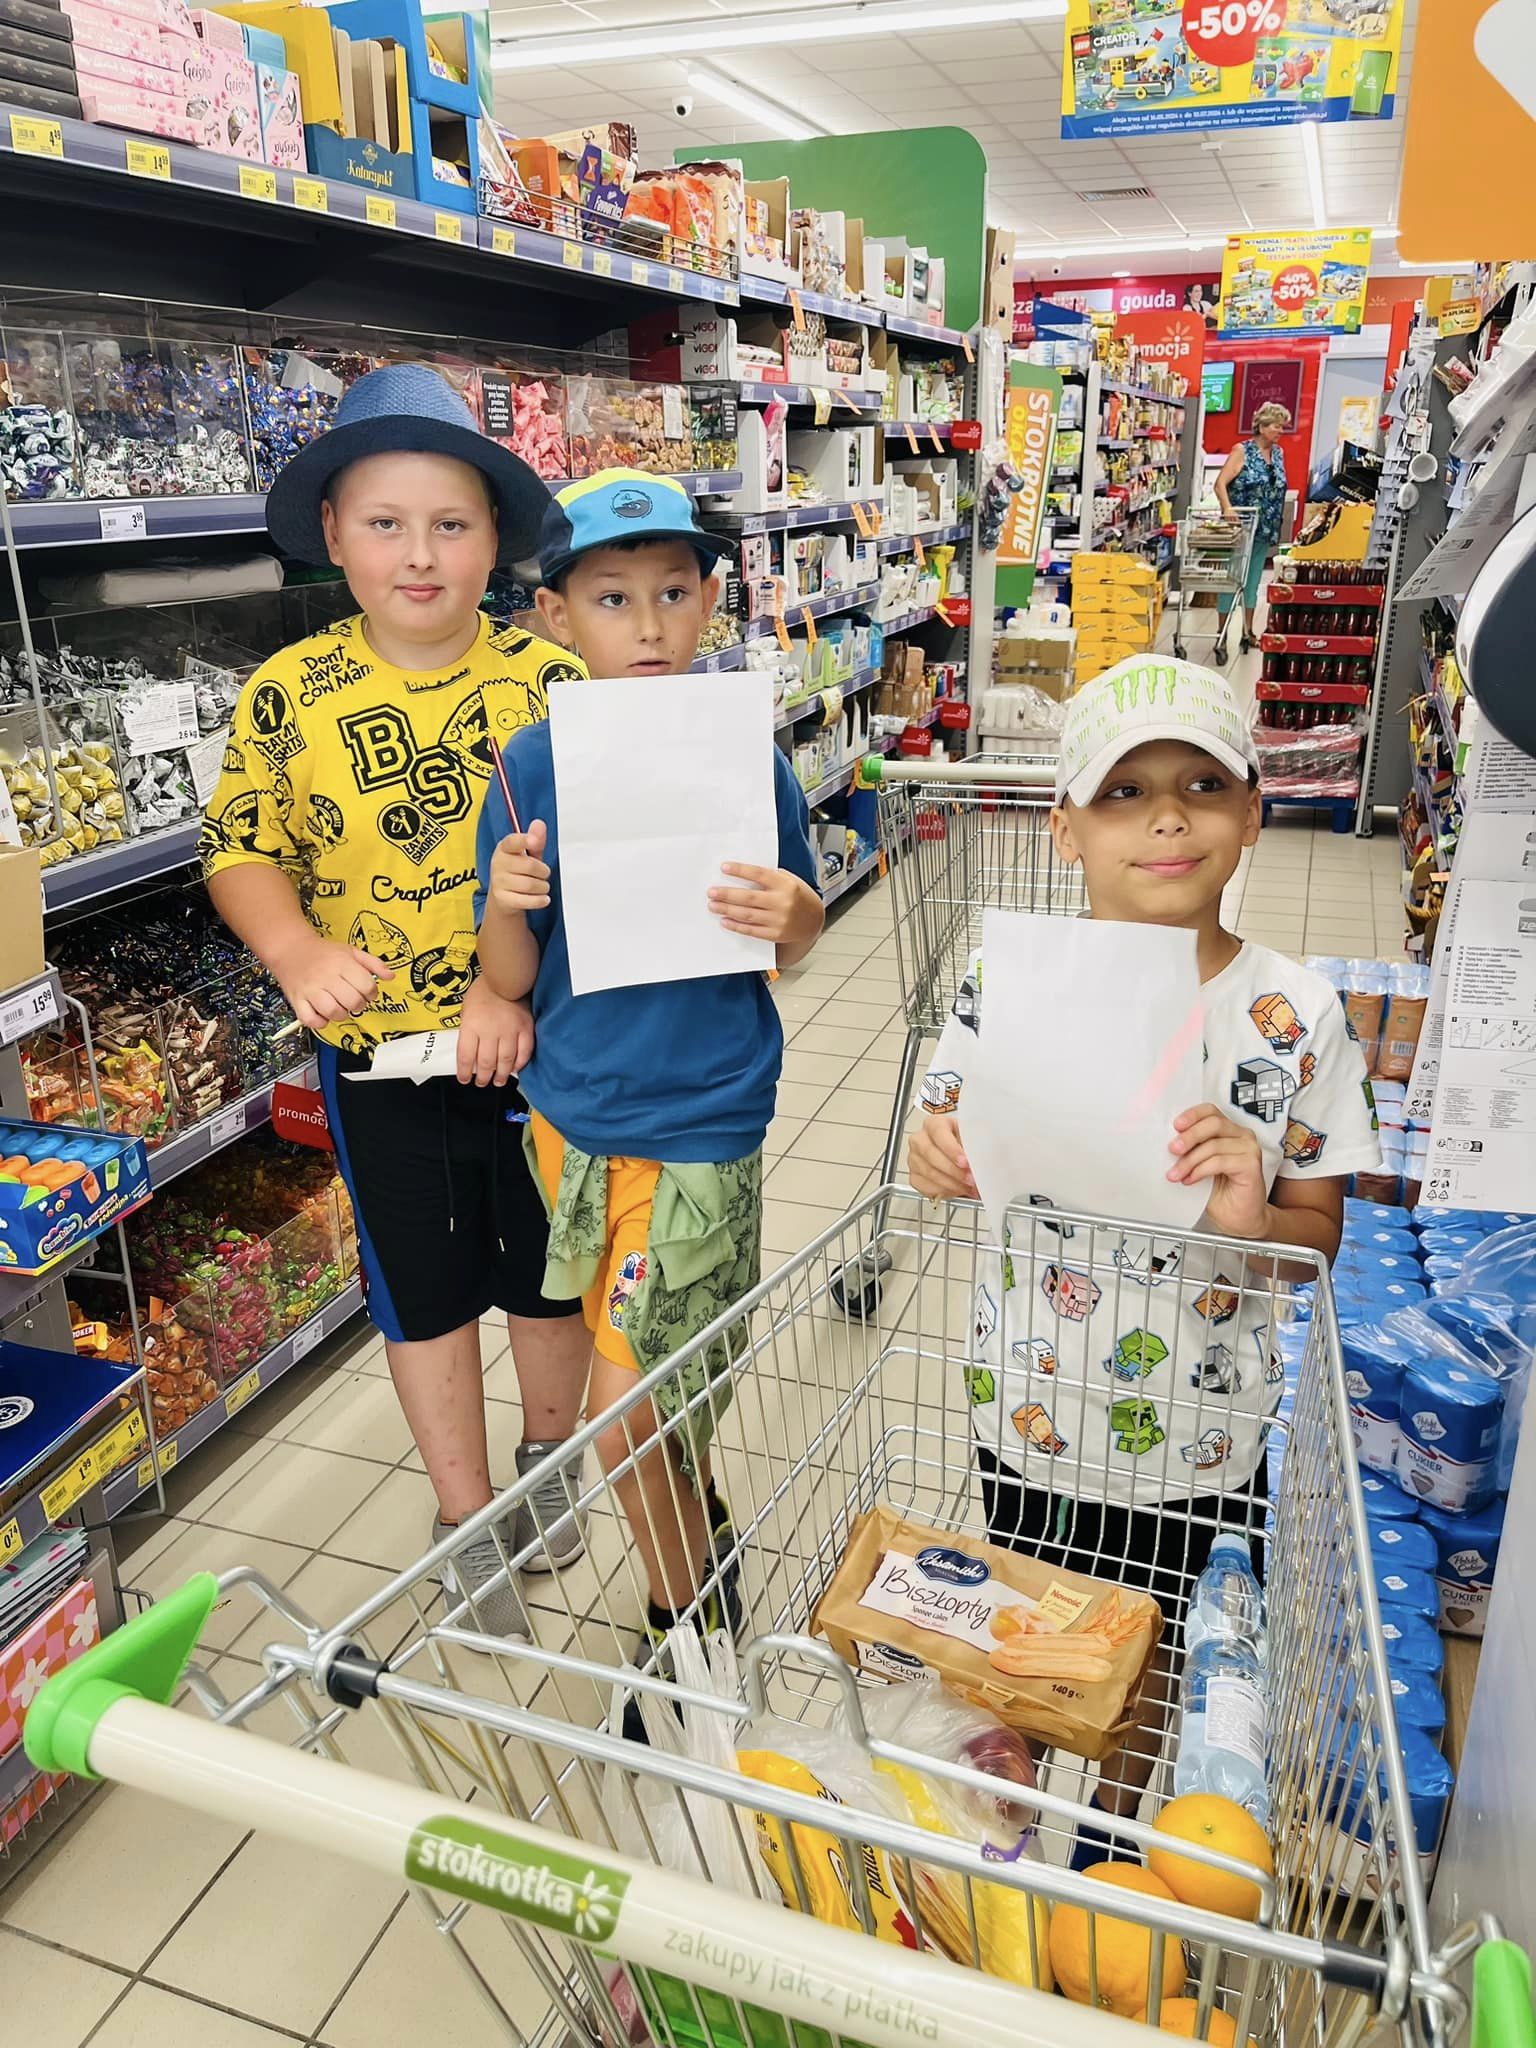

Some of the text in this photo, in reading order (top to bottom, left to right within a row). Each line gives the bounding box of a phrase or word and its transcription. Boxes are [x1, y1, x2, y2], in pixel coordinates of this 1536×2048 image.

[1186, 0, 1281, 39] -50%
[1093, 31, 1137, 47] CREATOR
[183, 58, 212, 82] Geisha
[224, 72, 250, 96] Geisha
[347, 159, 393, 189] Katarzynki
[1119, 289, 1176, 314] gouda
[1273, 283, 1315, 300] -50%
[1013, 391, 1050, 557] STOKROTNE
[300, 657, 358, 691] Have A
[262, 717, 298, 756] EAT MY
[402, 817, 435, 856] EAT MY
[411, 828, 445, 862] SHORTS
[425, 1031, 437, 1048] LIST
[1352, 1415, 1369, 1431] IER
[1407, 1449, 1443, 1474] CUKIER
[880, 1565, 992, 1631] Biszkopty
[1050, 1588, 1082, 1608] Nowość
[1441, 1588, 1485, 1603] CUKIER
[1052, 1683, 1075, 1698] 140 g
[416, 1833, 575, 1917] stokrotka
[662, 1924, 941, 2040] zakupy jak z płatka
